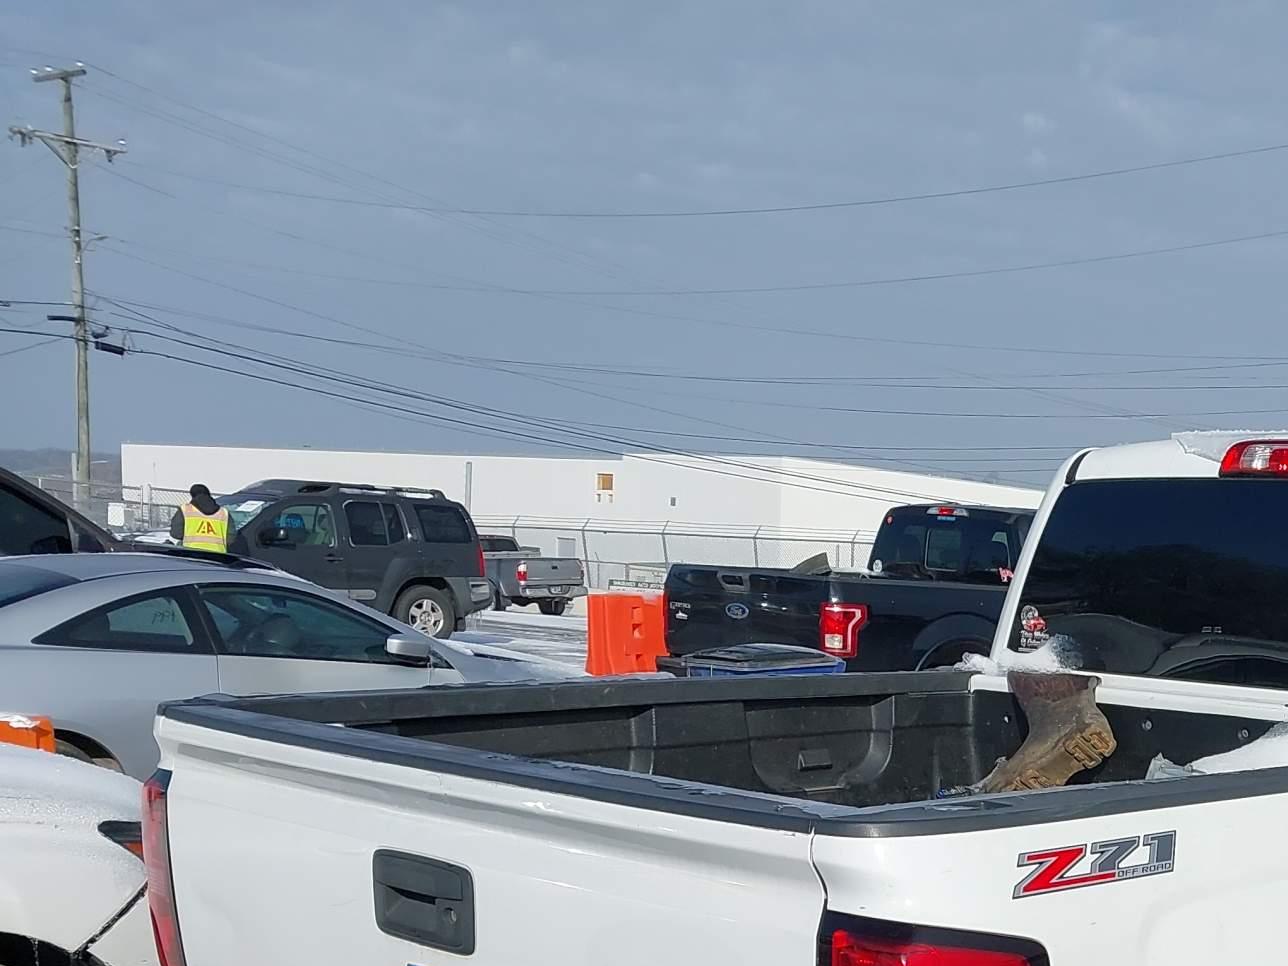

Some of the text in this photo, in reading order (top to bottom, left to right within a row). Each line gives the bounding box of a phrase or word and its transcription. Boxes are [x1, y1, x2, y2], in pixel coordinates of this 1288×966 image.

[1012, 830, 1177, 899] Z71
[1117, 862, 1172, 878] OFF ROAD
